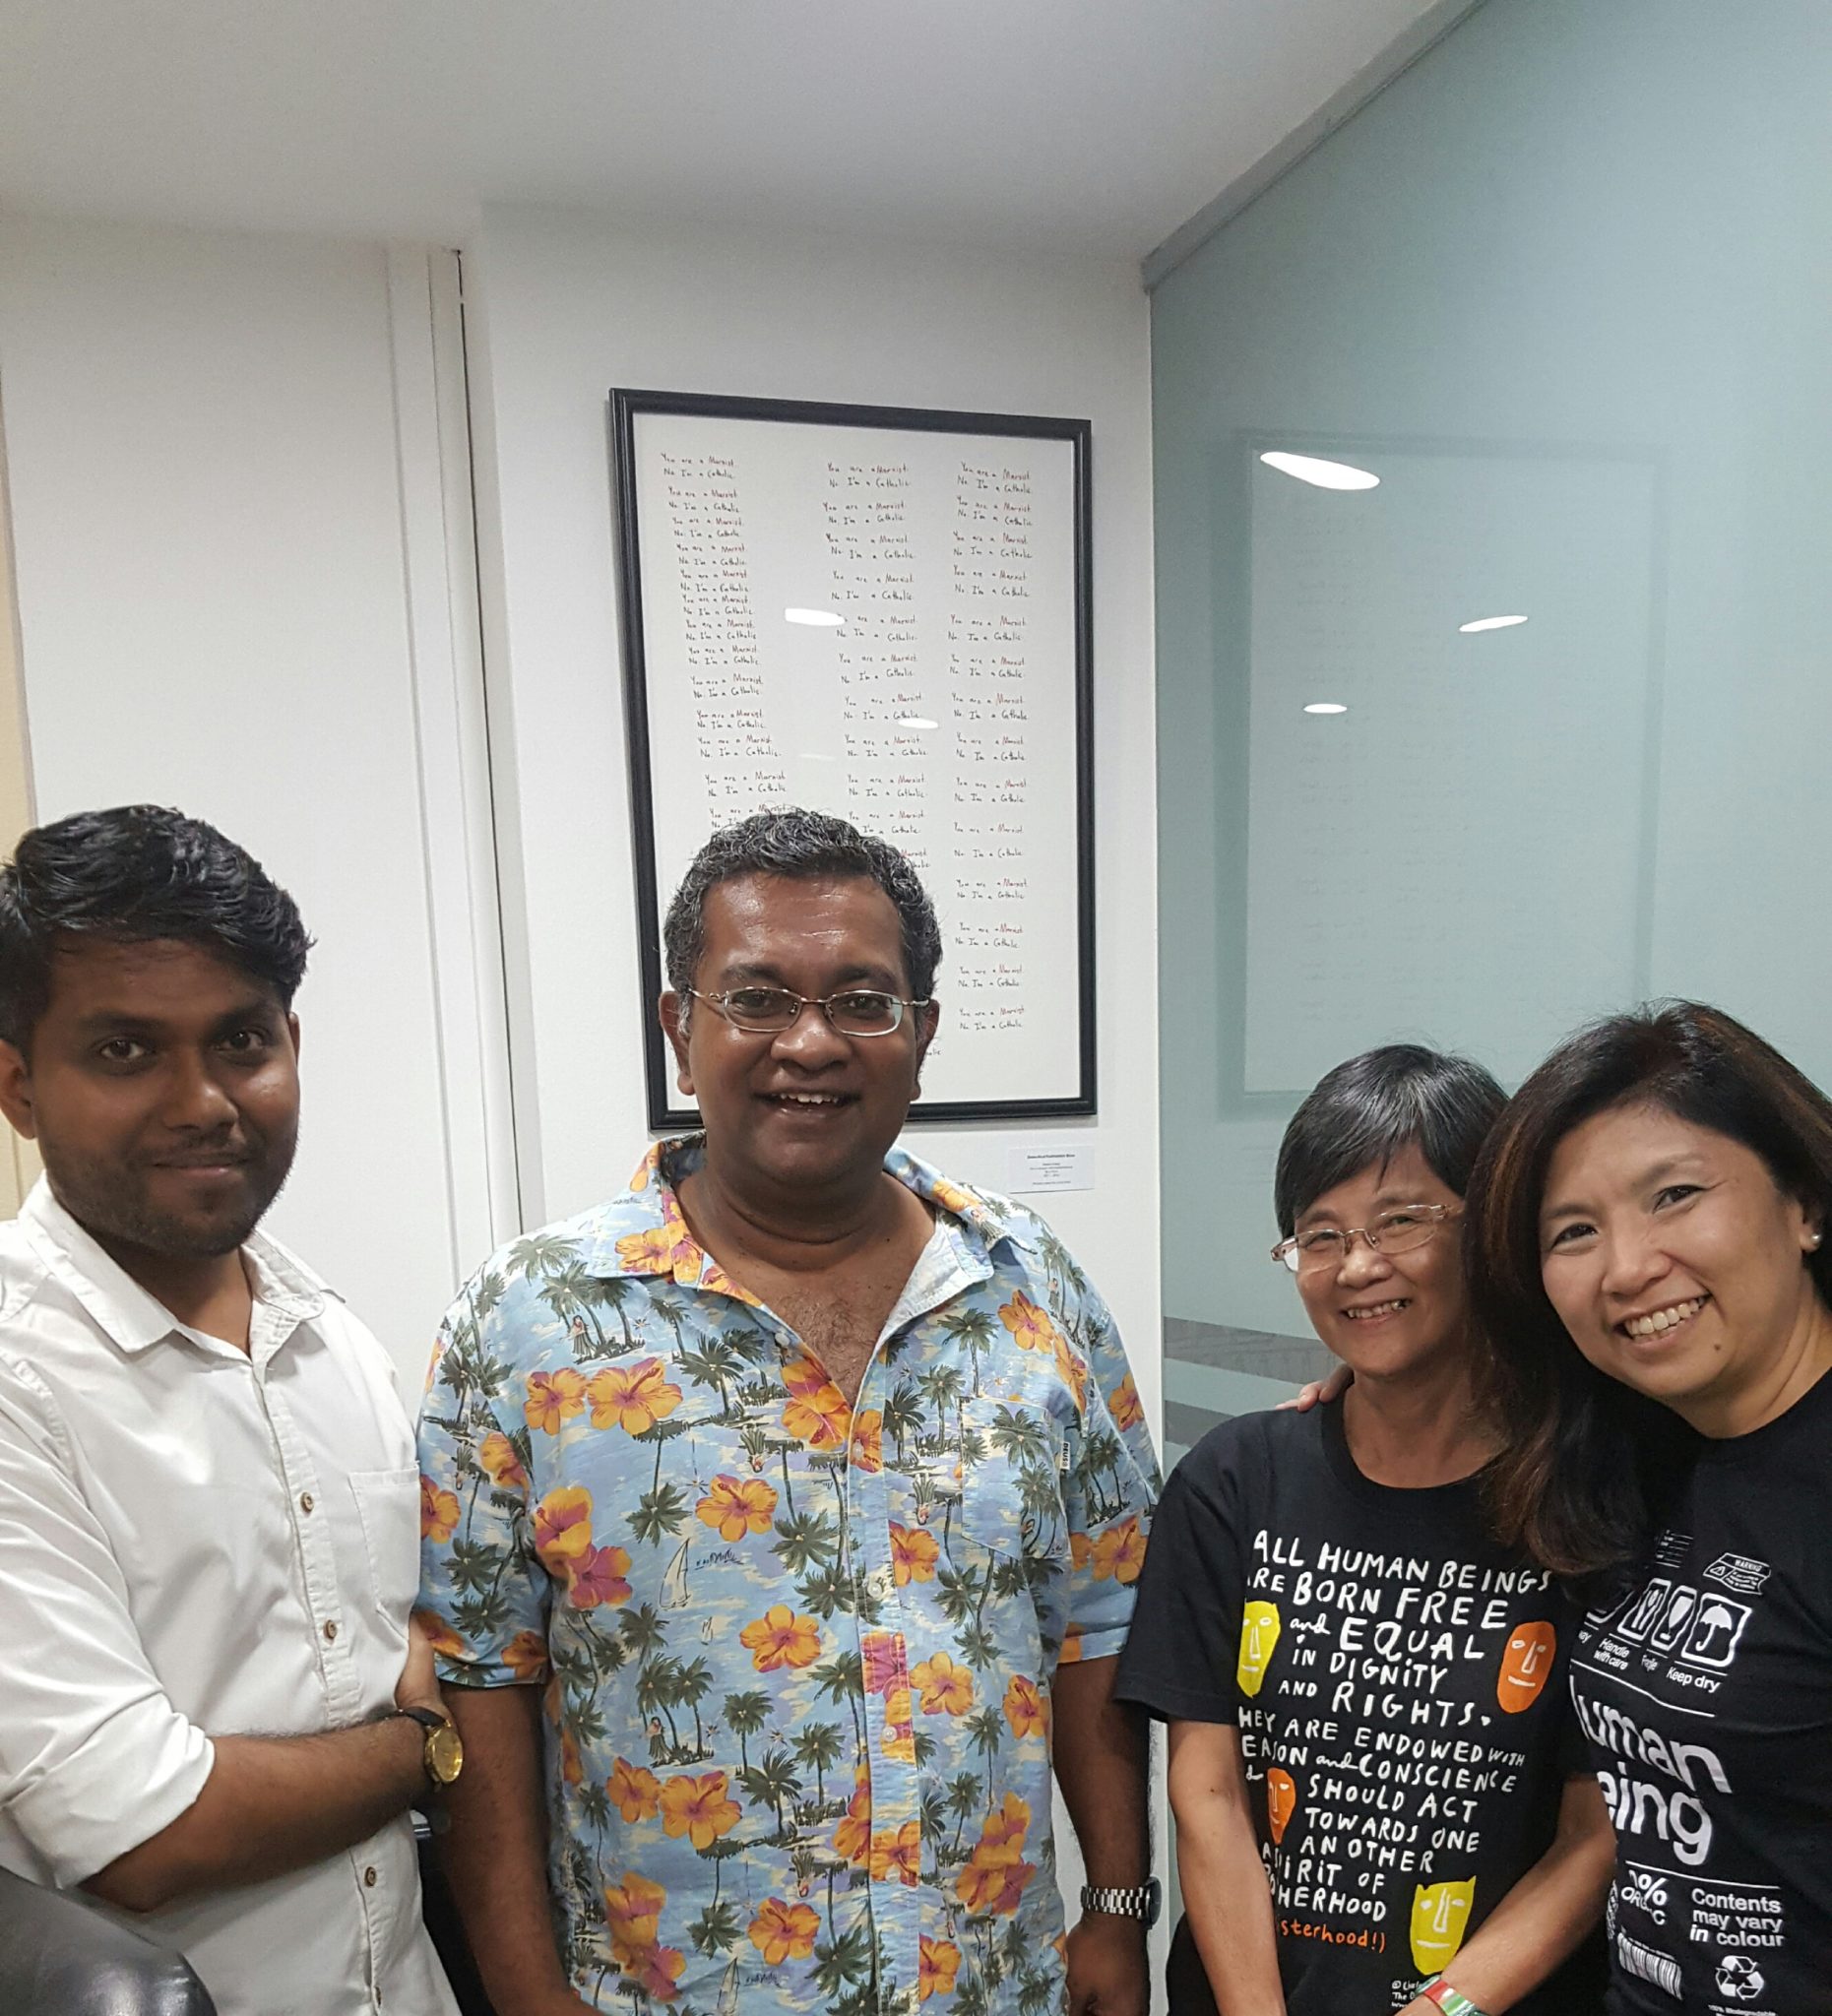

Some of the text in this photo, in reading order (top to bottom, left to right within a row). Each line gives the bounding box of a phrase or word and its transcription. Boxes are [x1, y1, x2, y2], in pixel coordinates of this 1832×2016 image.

[661, 453, 675, 463] You
[961, 462, 974, 473] You
[667, 485, 681, 496] You
[957, 495, 968, 506] You
[822, 501, 837, 512] You
[825, 533, 839, 542] You
[833, 570, 844, 580] You
[950, 613, 962, 624] You
[839, 653, 851, 663] You
[704, 774, 718, 786] You
[848, 774, 858, 784] You
[959, 1008, 971, 1017] You
[1253, 1529, 1551, 1594] ALL HUMAN BEINGS
[1247, 1567, 1508, 1629] RE BORN FREE
[1290, 1613, 1485, 1662] and EQUAL
[1599, 1638, 1630, 1658] Handle
[1609, 1657, 1628, 1670] care
[1666, 1667, 1721, 1694] Keep dry
[1279, 1679, 1491, 1727] AND RIGHTS.
[1238, 1706, 1276, 1732] HEY
[1285, 1720, 1338, 1740] ARE
[1355, 1728, 1482, 1763] ENDOWED
[1577, 1694, 1733, 1795] uman
[1241, 1735, 1517, 1793] EASON and CONSCIENCE
[1307, 1774, 1478, 1823] SHOULD ACT
[1597, 1761, 1713, 1866] eing
[1304, 1807, 1480, 1853] TOWARDS ONE
[1358, 1872, 1385, 1894] OF
[1691, 1888, 1782, 1914] Contents
[1693, 1910, 1783, 1933] may vary
[1281, 1919, 1386, 1953] sterhood!)
[1690, 1924, 1786, 1947] in colour
